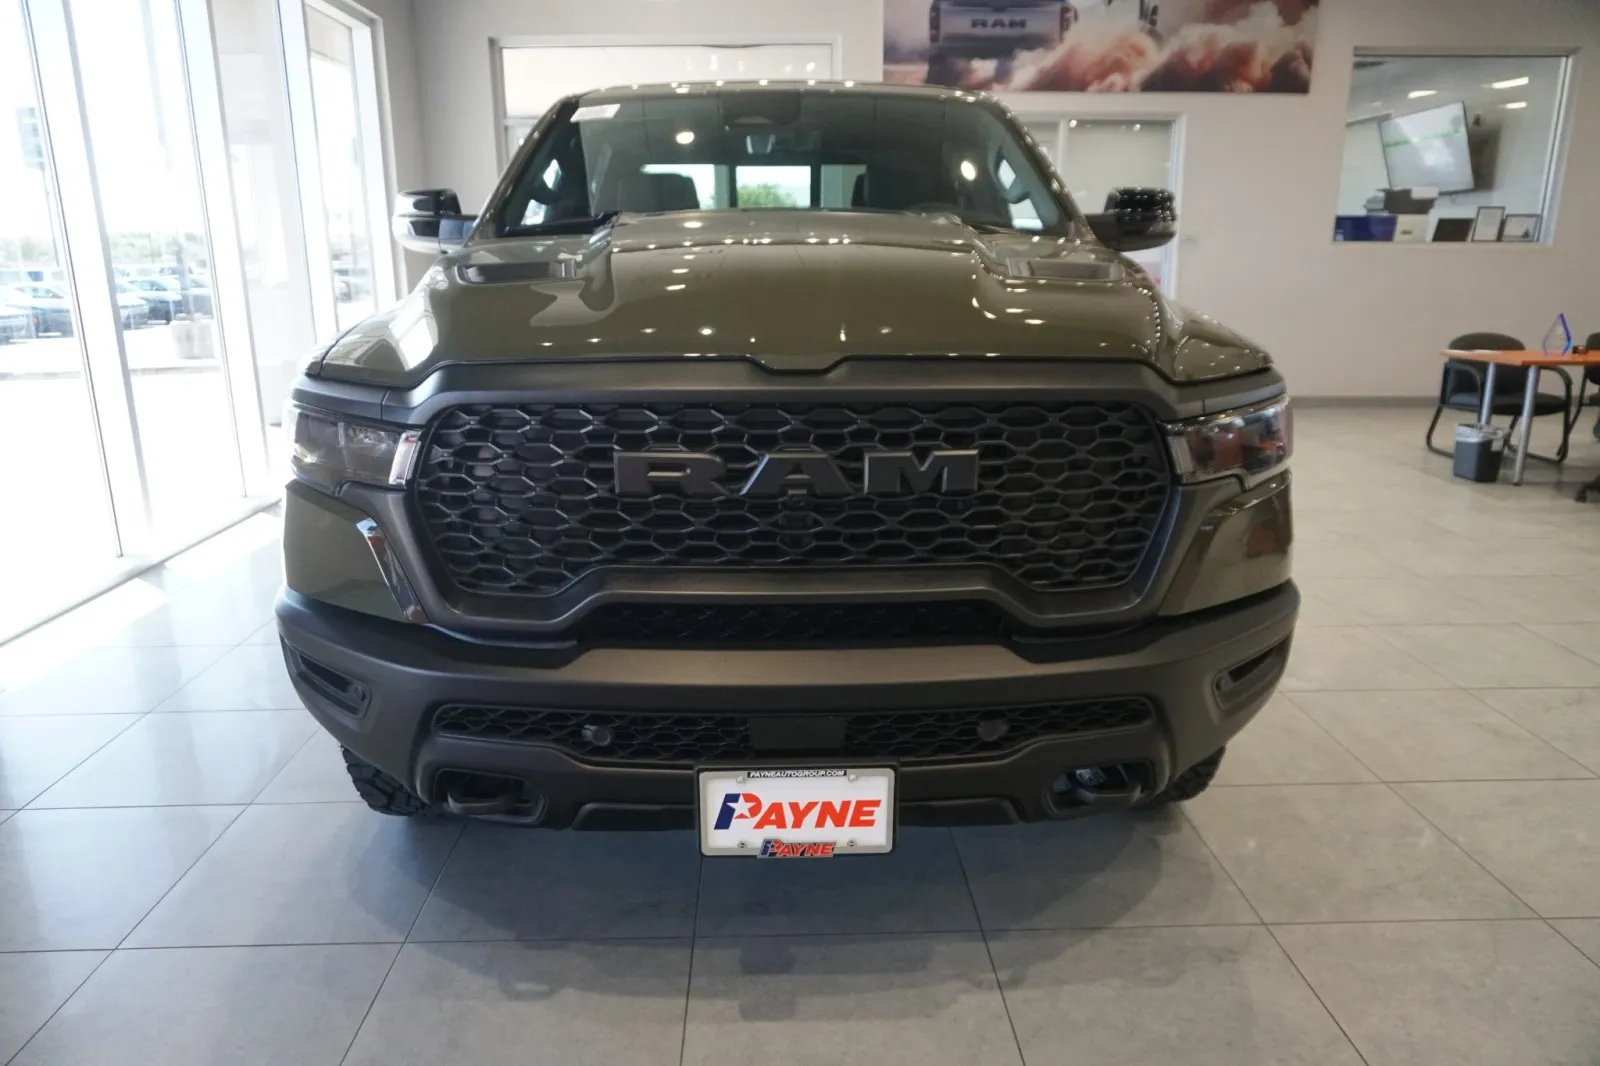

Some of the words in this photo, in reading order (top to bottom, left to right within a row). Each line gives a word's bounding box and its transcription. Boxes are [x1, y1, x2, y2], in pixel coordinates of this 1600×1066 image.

[971, 18, 1027, 29] RAM
[613, 449, 980, 496] RAM
[749, 770, 845, 778] PAYNEAUTOGROUP.COM
[714, 793, 881, 830] PAYNE
[760, 839, 834, 856] PAYNE
